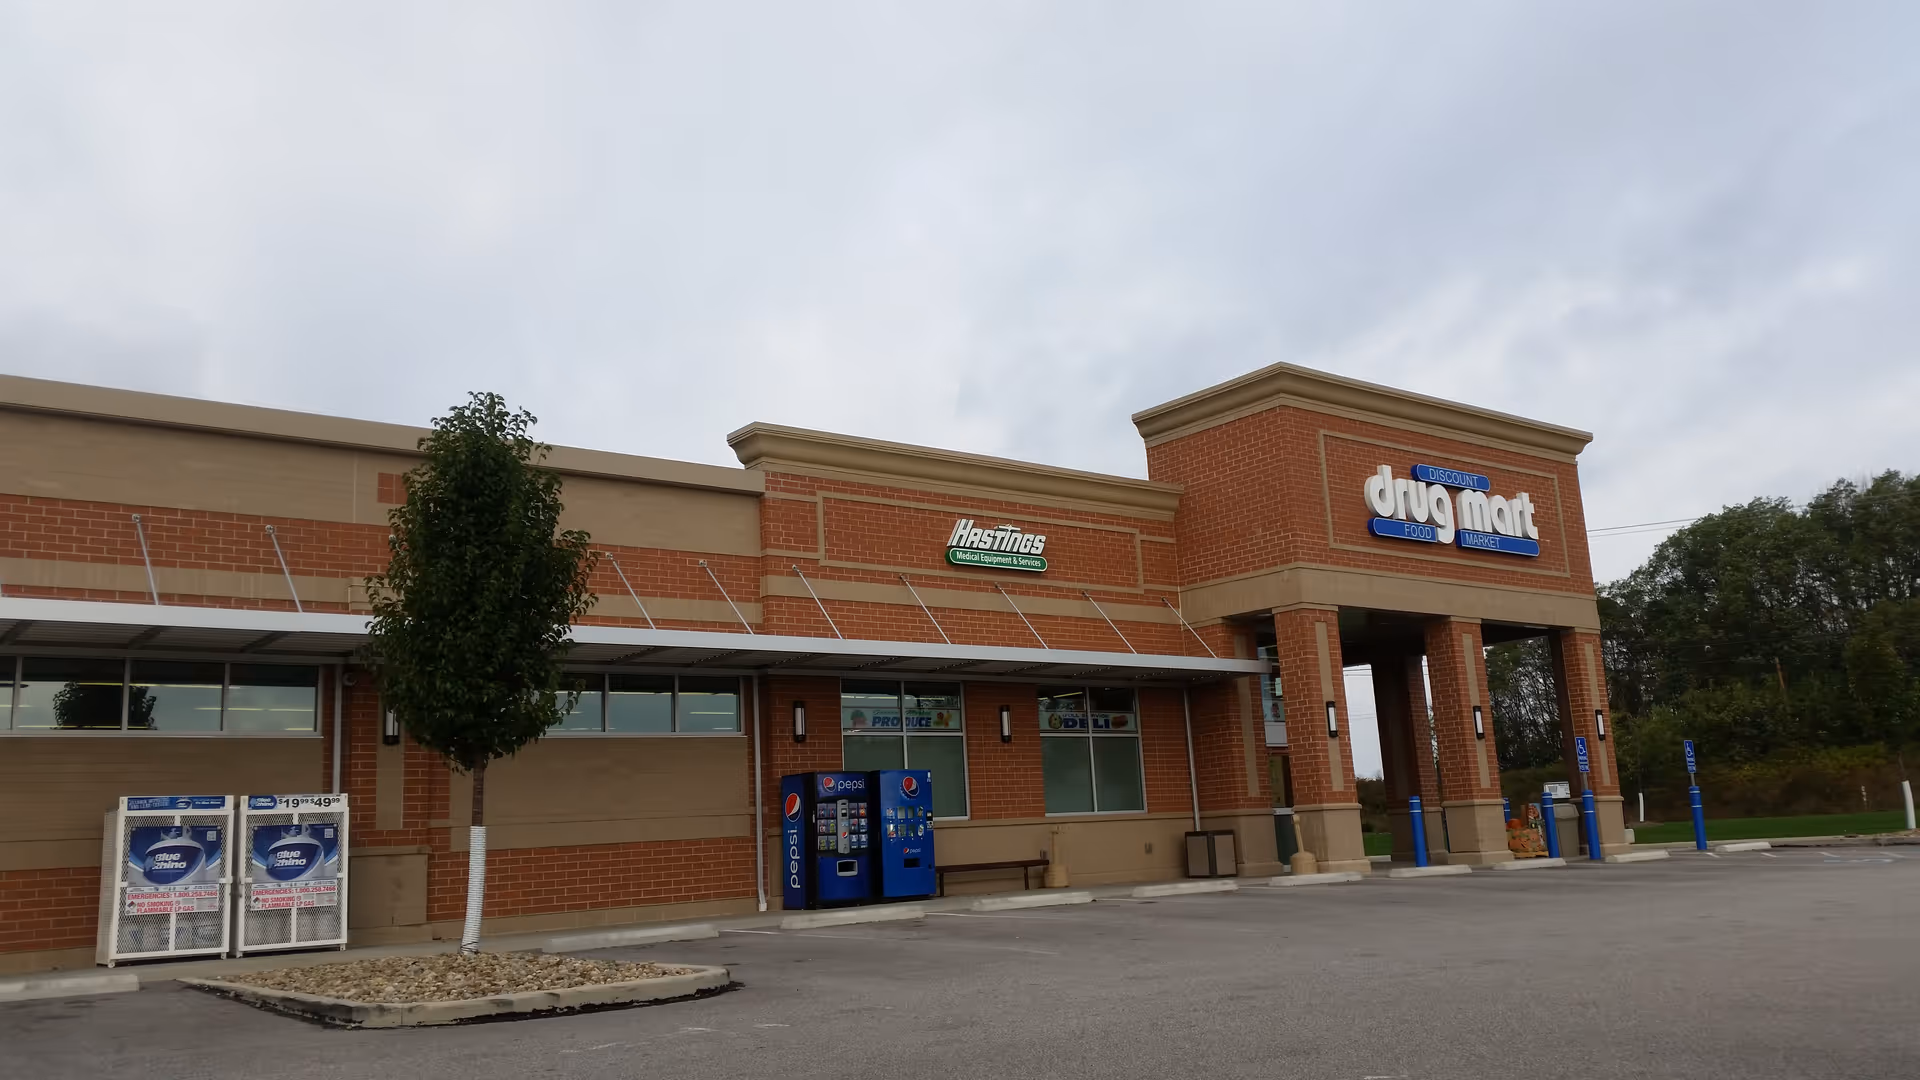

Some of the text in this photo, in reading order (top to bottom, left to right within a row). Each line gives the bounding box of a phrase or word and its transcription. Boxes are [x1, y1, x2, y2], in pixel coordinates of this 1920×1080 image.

[1428, 468, 1479, 488] DISCOUNT
[1364, 464, 1539, 544] drug mart
[1404, 523, 1500, 549] FOOD MARKET
[956, 551, 1041, 567] Medical Equipment & Services
[872, 716, 932, 728] PRODUCE
[1063, 717, 1111, 729] DELI
[838, 779, 865, 791] pepsi
[155, 853, 180, 862] Blue
[276, 850, 301, 859] Blue
[788, 829, 800, 889] pepsi
[136, 906, 173, 914] FLAMMABLE
[261, 901, 295, 909] FLAMMABLE
